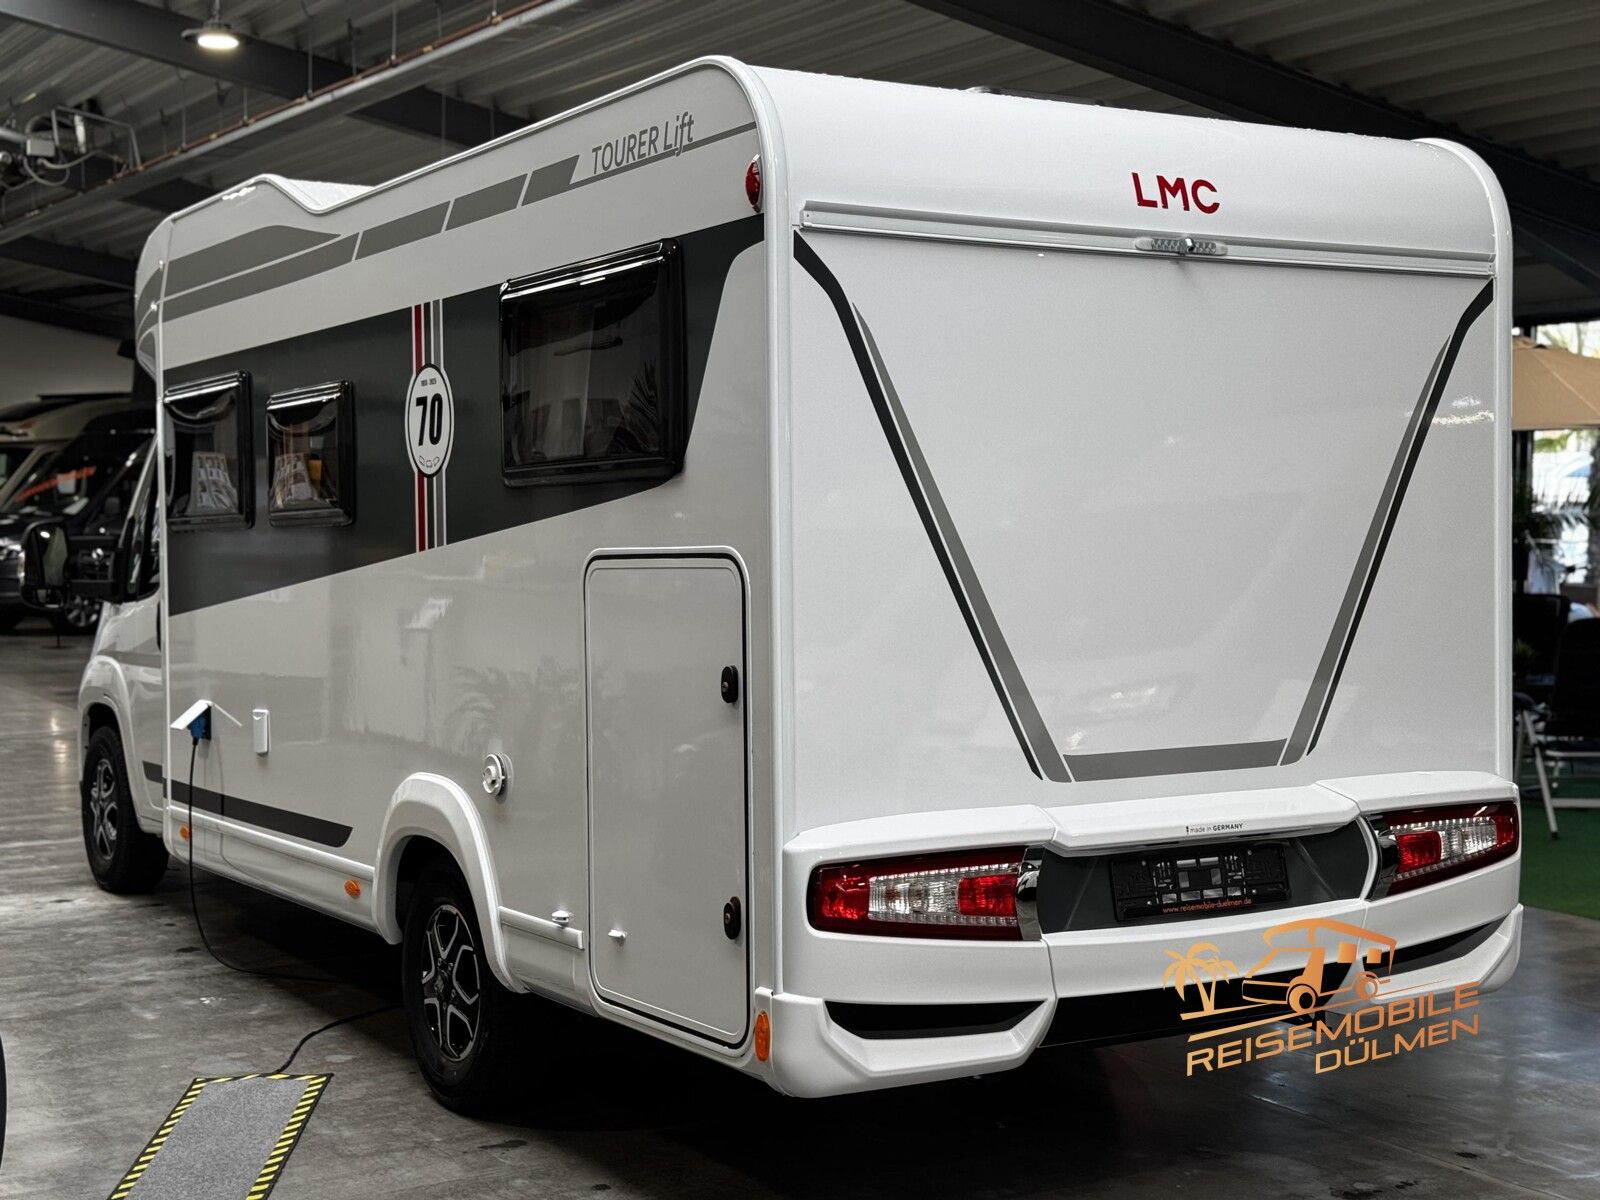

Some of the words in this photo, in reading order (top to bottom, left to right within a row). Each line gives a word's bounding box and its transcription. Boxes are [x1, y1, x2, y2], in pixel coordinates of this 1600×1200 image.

[592, 126, 660, 175] TOURER
[663, 111, 695, 157] Lift
[1131, 172, 1220, 214] LMC
[415, 393, 443, 447] 70
[1212, 823, 1243, 831] GERMANY
